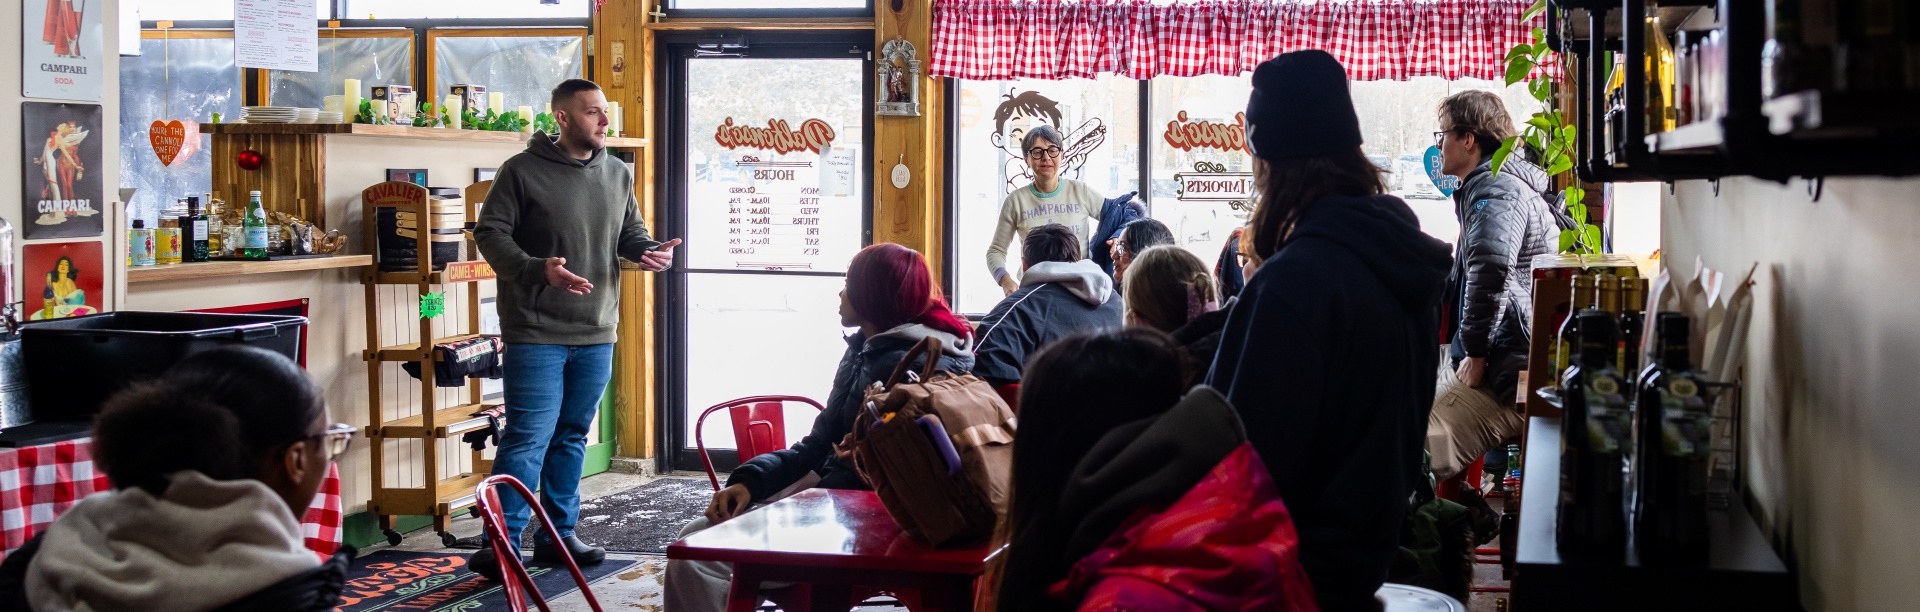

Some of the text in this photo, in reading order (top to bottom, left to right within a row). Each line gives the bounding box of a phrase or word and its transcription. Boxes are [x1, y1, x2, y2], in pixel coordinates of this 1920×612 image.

[40, 63, 88, 75] CAMPARI
[54, 77, 74, 85] SODA
[170, 127, 184, 136] THE
[154, 135, 183, 147] CANNOLI
[155, 146, 179, 155] ONE FOR
[161, 154, 172, 162] ME
[365, 183, 423, 204] CAVALIER
[37, 198, 92, 214] CAMPARI
[1022, 203, 1081, 221] CHAMPAGNE
